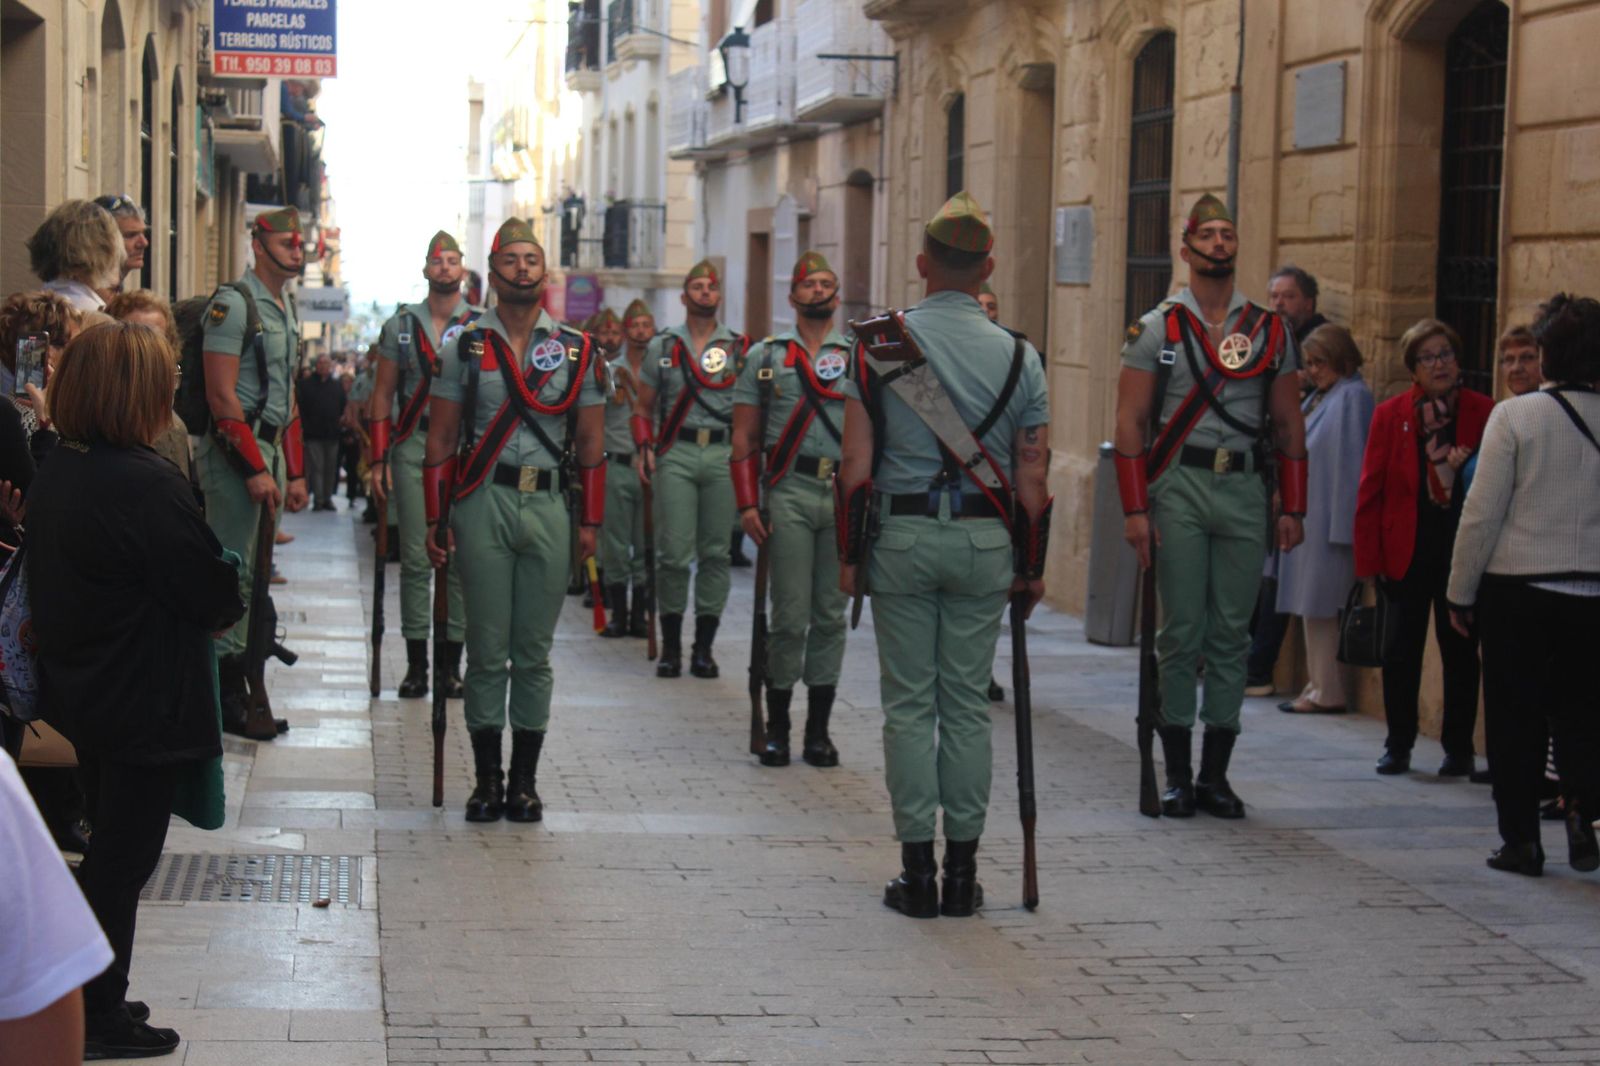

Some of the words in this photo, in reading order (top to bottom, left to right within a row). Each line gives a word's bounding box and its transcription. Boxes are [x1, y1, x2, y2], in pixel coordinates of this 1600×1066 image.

[246, 13, 305, 28] PARCELAS
[220, 32, 276, 48] TERRENOS
[280, 32, 333, 50] RÚSTICOS
[246, 56, 272, 73] 950
[274, 57, 292, 73] 39
[294, 57, 313, 74] 08
[314, 58, 333, 75] 03
